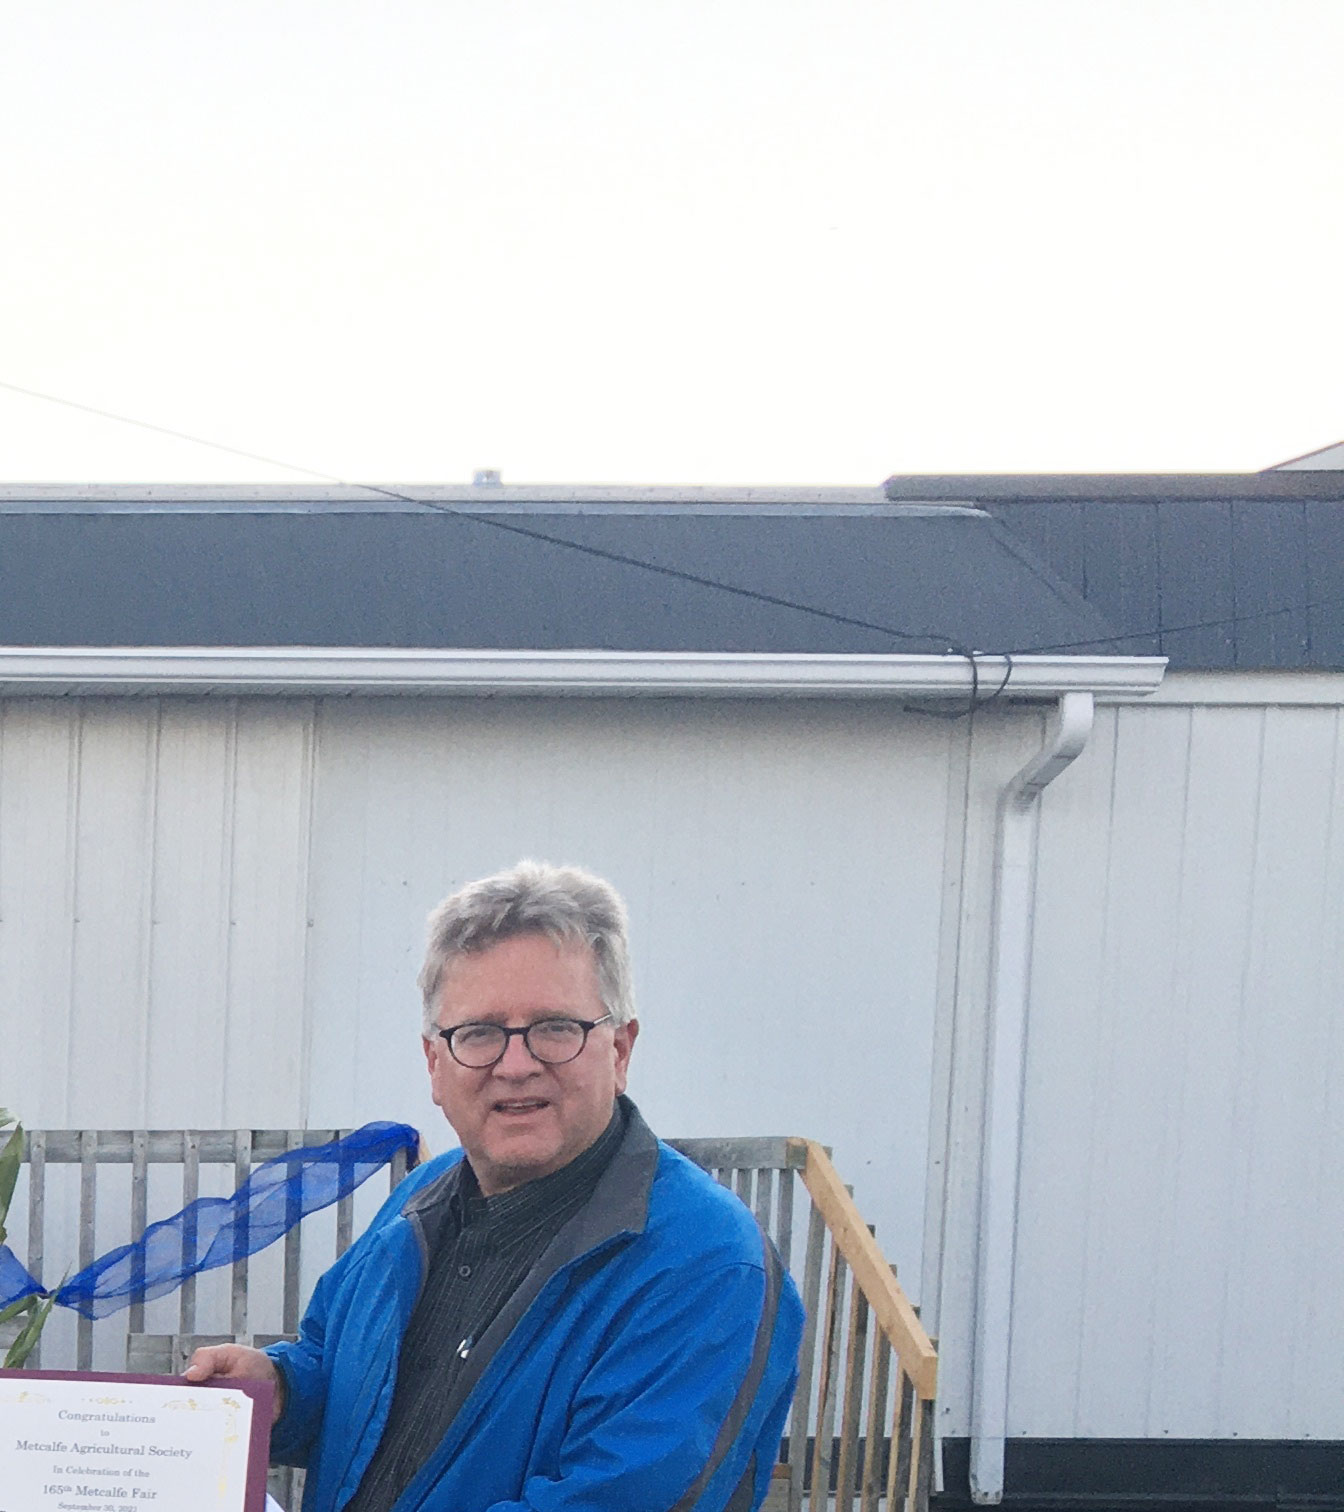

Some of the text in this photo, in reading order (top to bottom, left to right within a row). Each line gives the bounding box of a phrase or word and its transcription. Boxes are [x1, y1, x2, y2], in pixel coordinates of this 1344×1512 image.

[58, 1410, 156, 1424] Congratulations
[15, 1440, 193, 1460] Metcalfe Agricultural Society
[53, 1465, 151, 1478] In Celebration of the
[75, 1485, 128, 1498] Metcalfe
[132, 1487, 158, 1500] Fair
